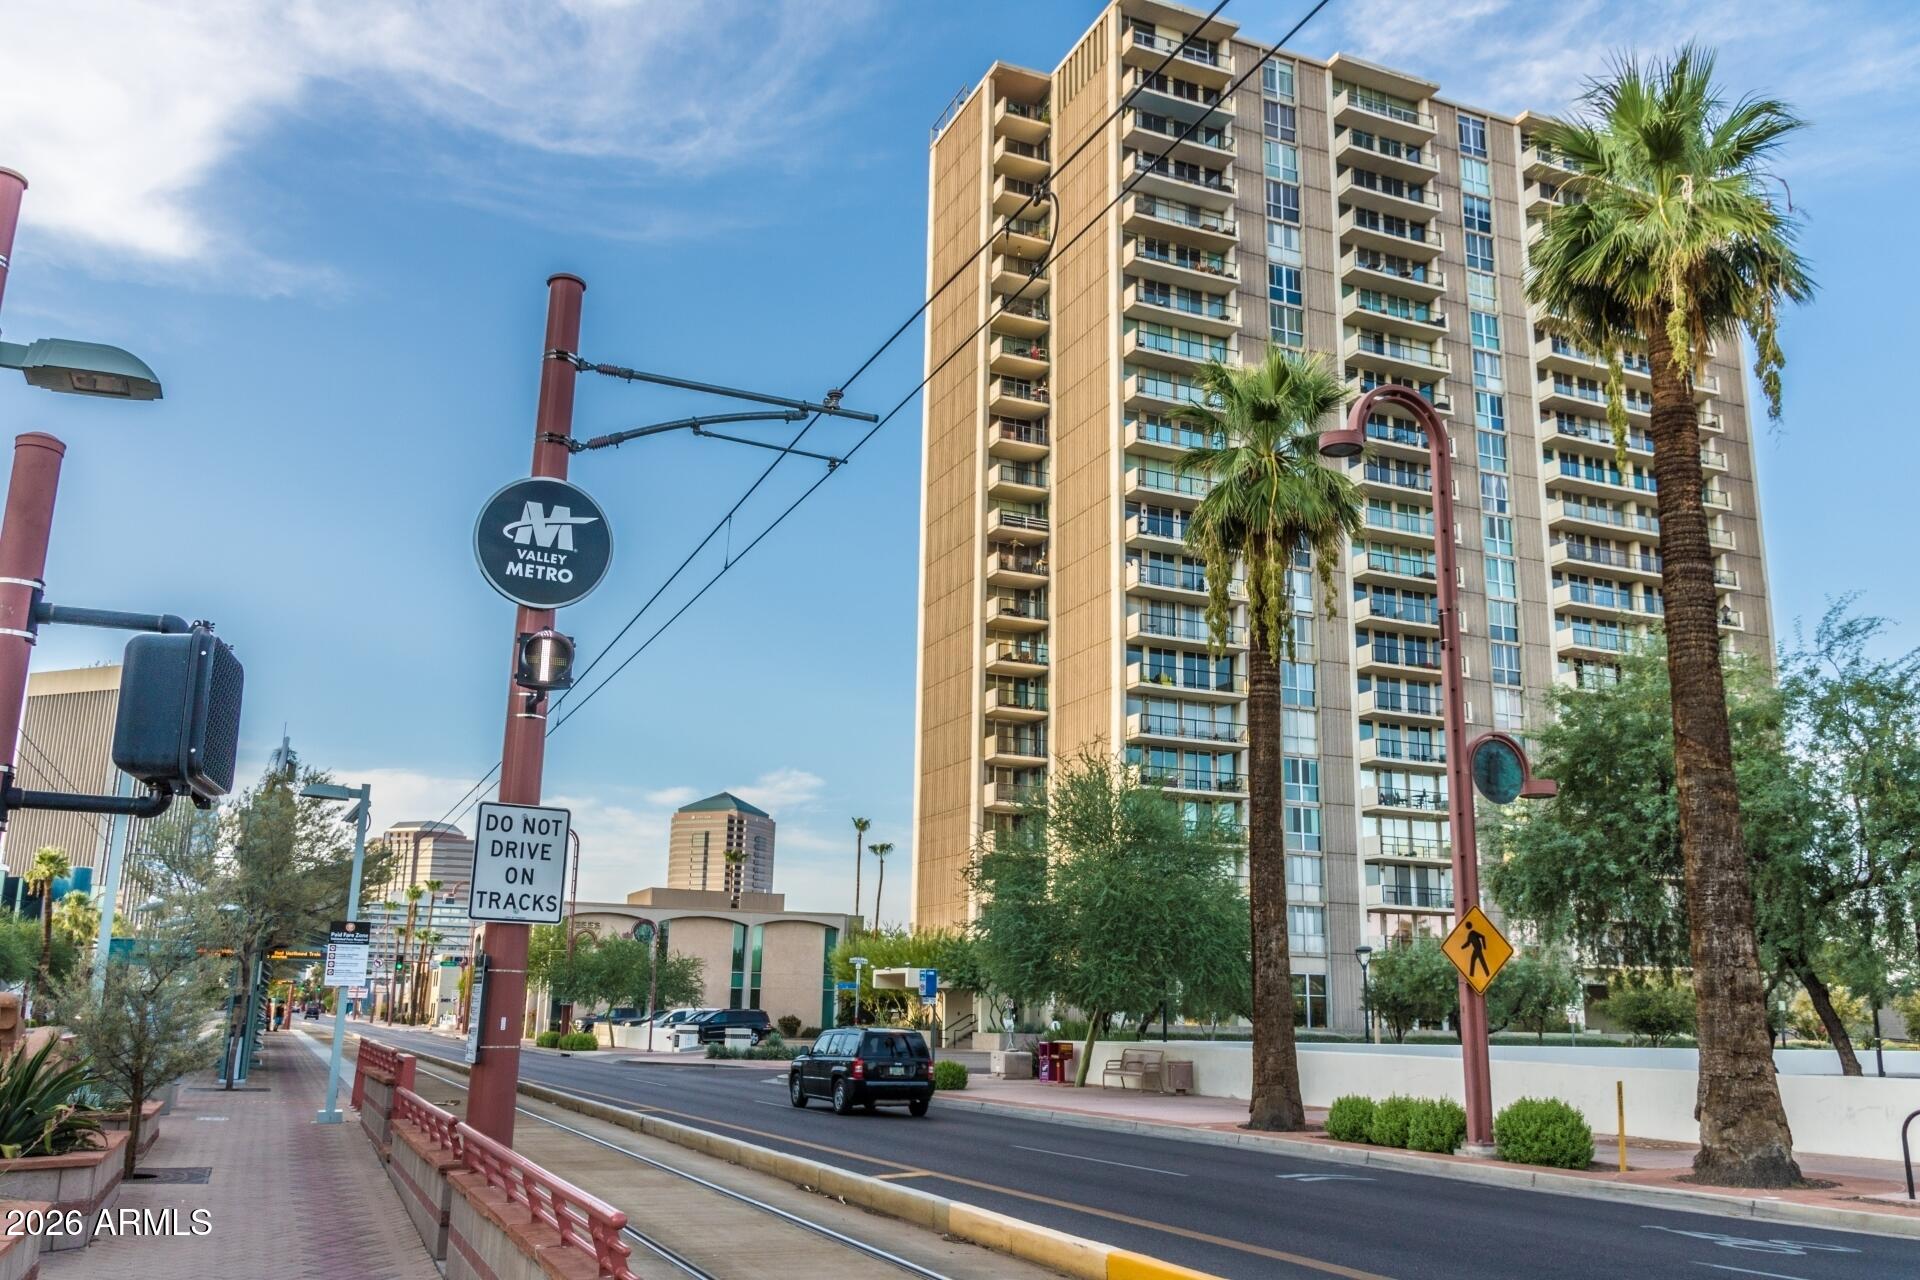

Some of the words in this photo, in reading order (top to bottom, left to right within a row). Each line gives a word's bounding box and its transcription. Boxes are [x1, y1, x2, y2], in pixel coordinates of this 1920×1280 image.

[516, 548, 568, 565] VALLEY
[505, 561, 574, 584] METRO
[486, 814, 513, 833] DO
[522, 817, 563, 837] NOT
[491, 840, 552, 861] DRIVE
[505, 867, 535, 885] ON
[476, 891, 557, 912] TRACKS
